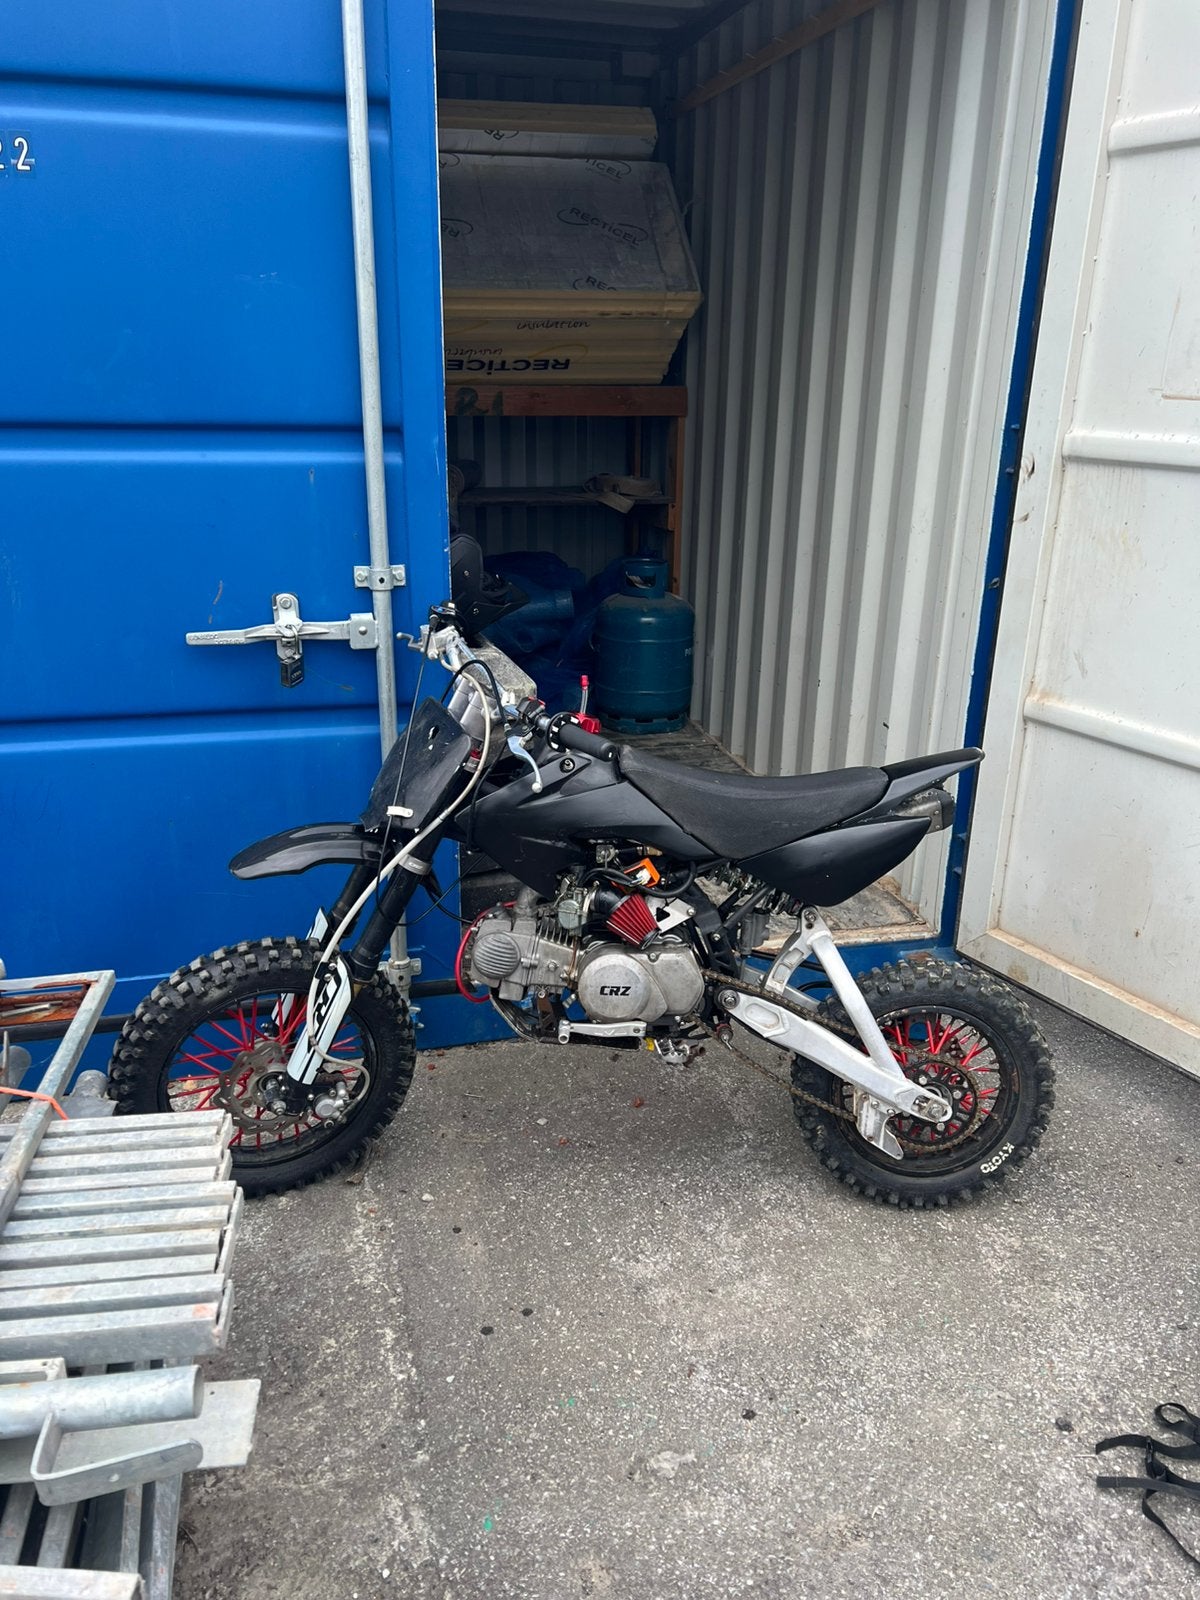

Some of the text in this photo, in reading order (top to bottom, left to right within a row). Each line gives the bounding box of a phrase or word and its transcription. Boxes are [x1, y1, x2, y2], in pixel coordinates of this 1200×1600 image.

[0, 136, 31, 171] 2
[446, 358, 571, 375] RECTICE
[599, 985, 632, 997] CRZ
[980, 1142, 1015, 1174] KYOTO
